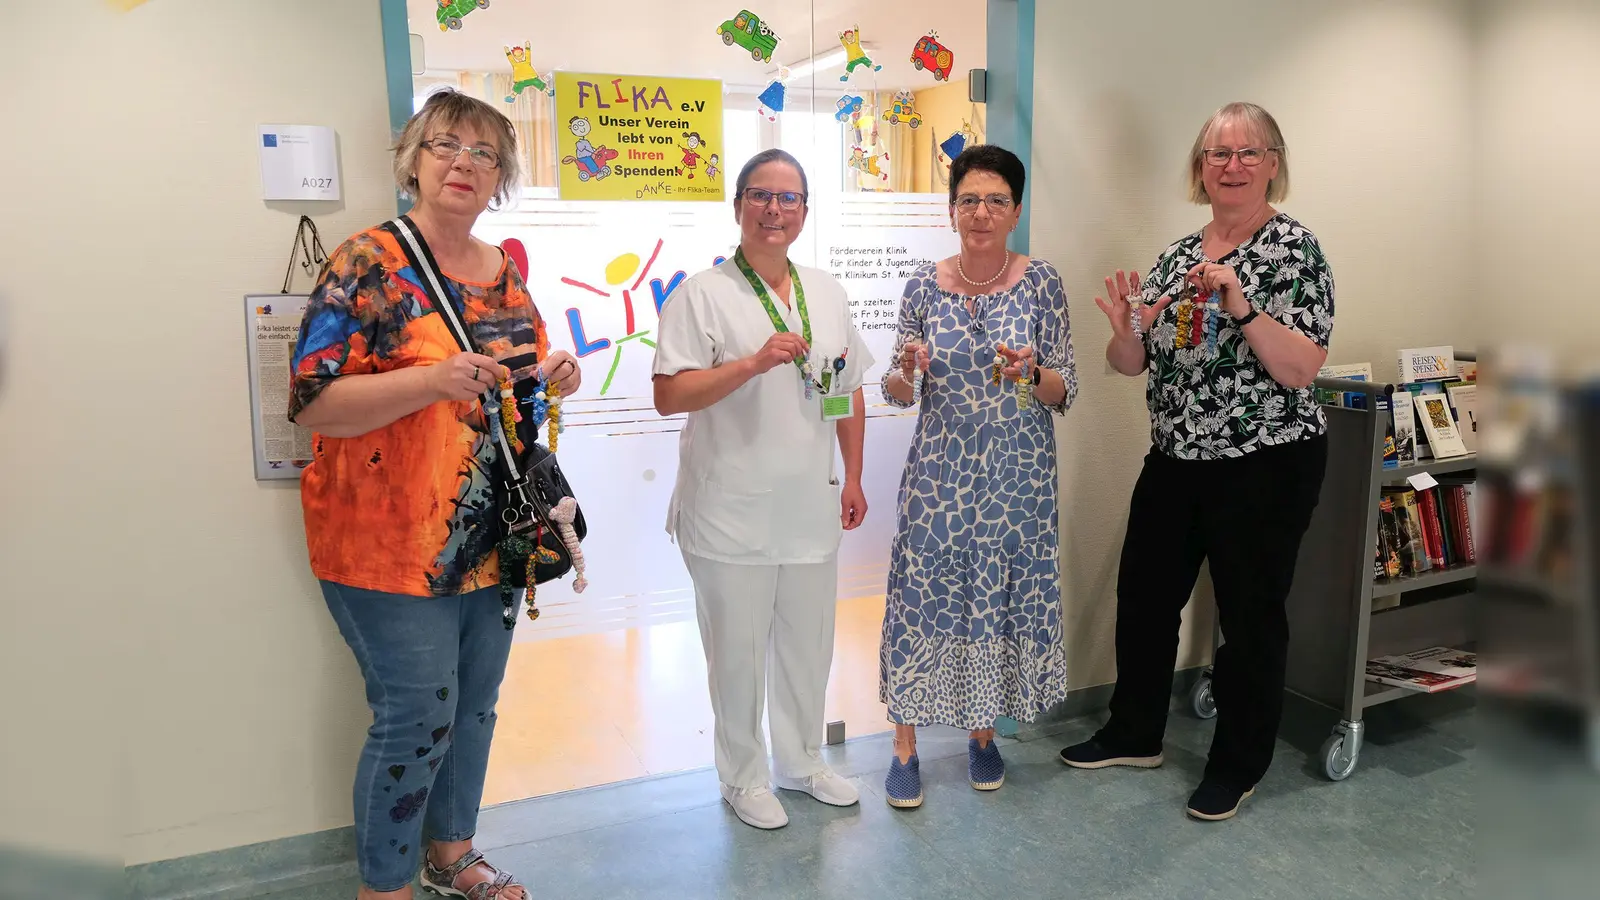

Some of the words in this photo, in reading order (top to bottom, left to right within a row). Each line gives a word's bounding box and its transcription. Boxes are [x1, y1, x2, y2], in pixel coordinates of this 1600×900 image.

[577, 78, 673, 112] FLIKA
[680, 100, 706, 113] e.V
[598, 115, 642, 128] Unser
[645, 117, 690, 129] Verein
[617, 132, 645, 144] lebt
[649, 135, 673, 145] von
[628, 149, 665, 161] Ihren
[614, 165, 680, 178] Spenden!
[302, 178, 332, 189] A027
[635, 181, 673, 199] DANKE
[677, 186, 687, 194] Ihr
[687, 186, 721, 194] Flika-Team
[830, 246, 883, 255] Förderverein
[886, 247, 908, 255] Klinik
[830, 258, 844, 267] für
[847, 258, 873, 267] Kinder
[876, 259, 882, 267] &
[845, 271, 878, 279] Klinikum
[881, 271, 894, 279] St.
[860, 310, 871, 318] Fr
[873, 310, 880, 318] 9
[882, 310, 895, 318] bis
[1412, 355, 1438, 366] REISEN
[1412, 364, 1440, 374] SPEISEN
